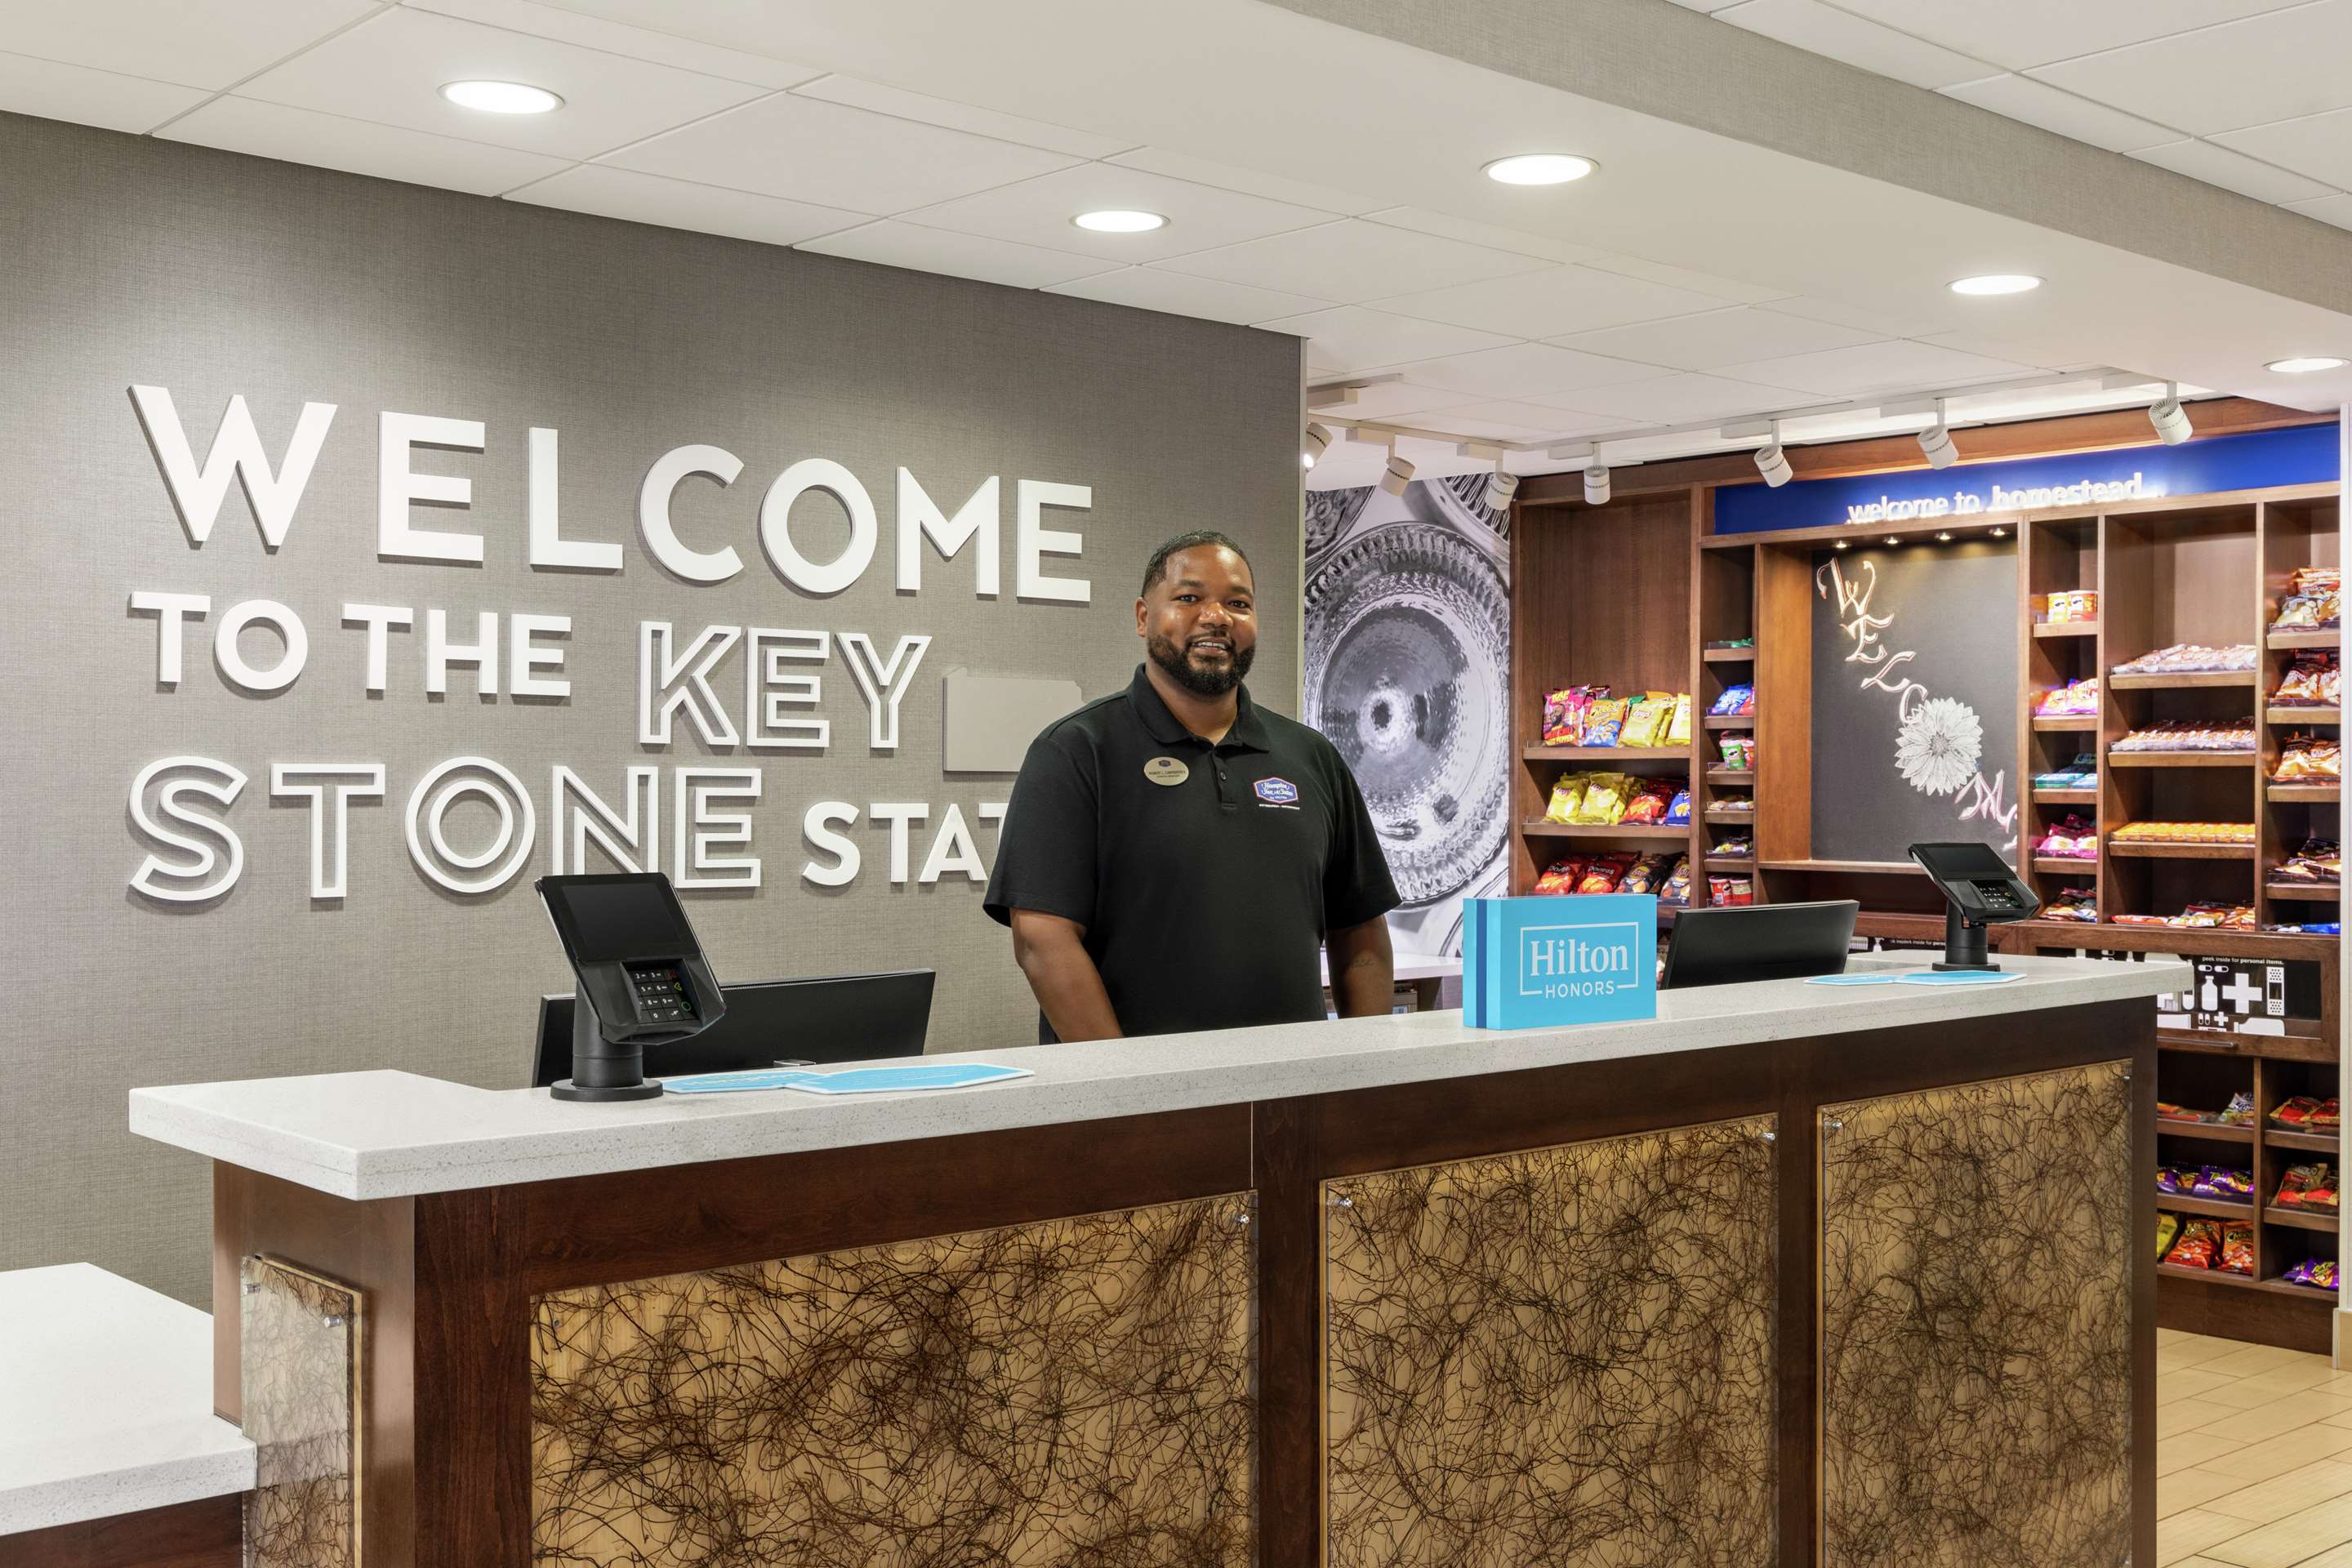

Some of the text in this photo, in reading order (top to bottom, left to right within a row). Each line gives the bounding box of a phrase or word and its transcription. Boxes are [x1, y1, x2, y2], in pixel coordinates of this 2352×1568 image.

[127, 385, 1092, 603] WELCOME
[1846, 472, 2143, 523] welcome to homestead
[131, 590, 933, 749] TO THE KEY
[128, 755, 762, 902] STONE
[1530, 939, 1629, 977] Hilton
[1545, 981, 1615, 999] HONORS
